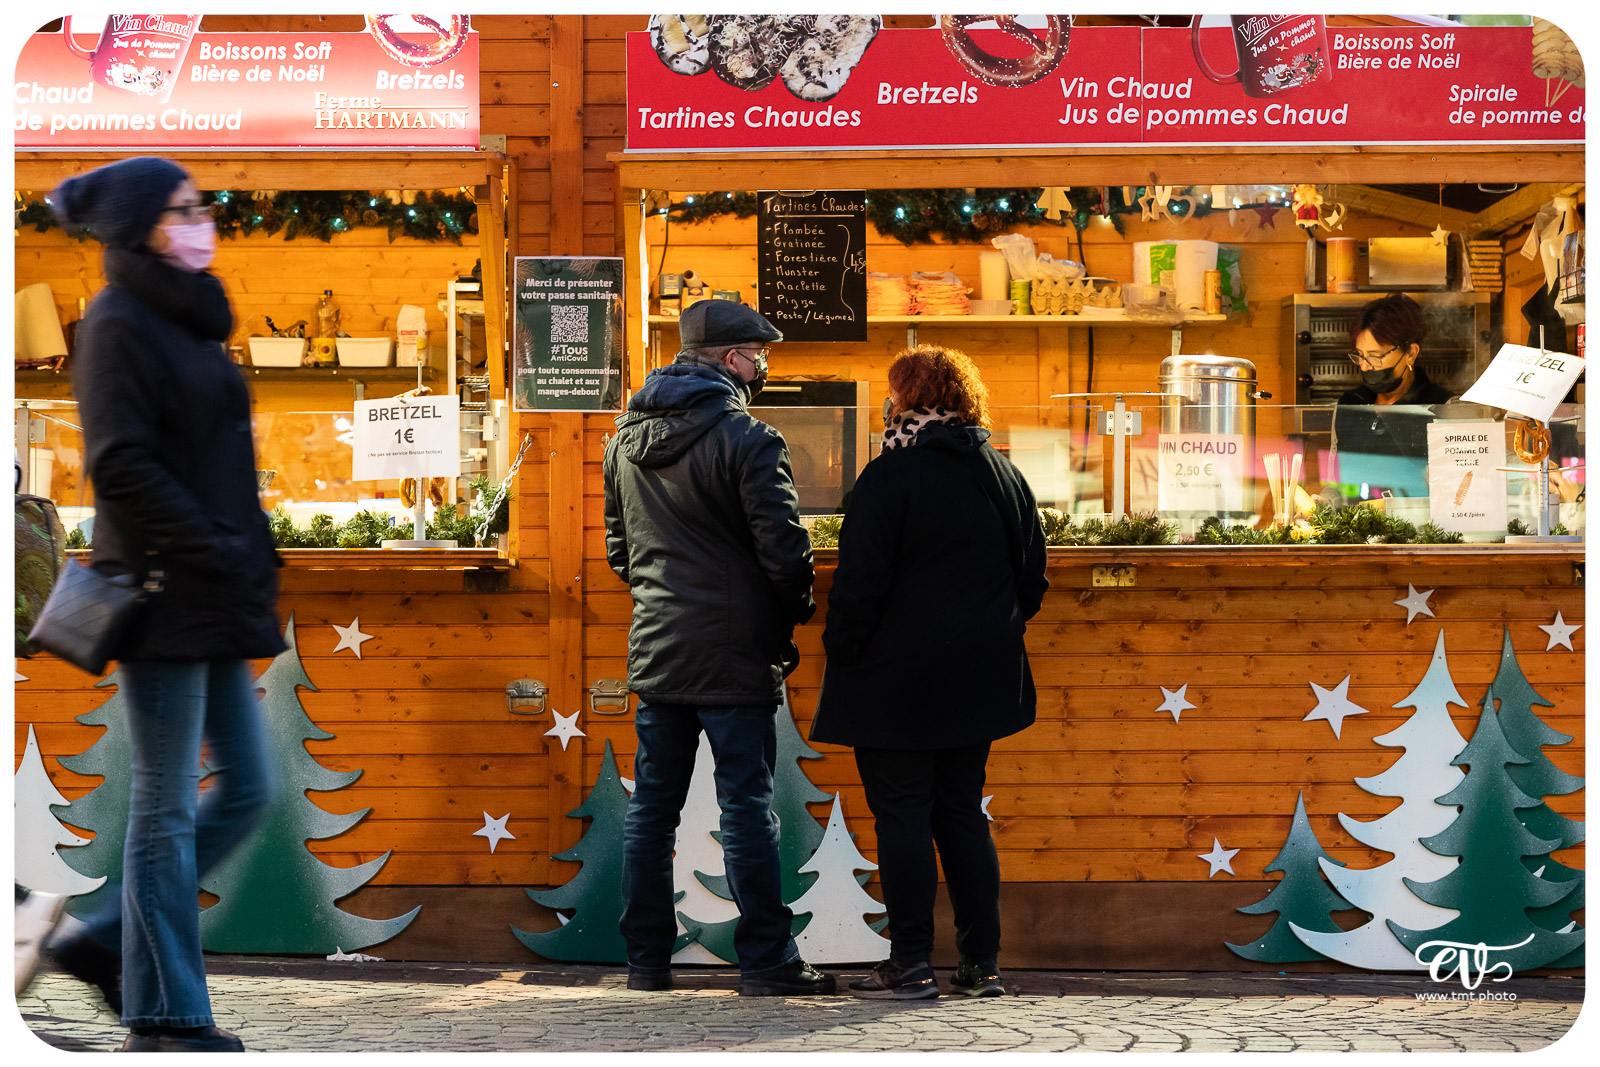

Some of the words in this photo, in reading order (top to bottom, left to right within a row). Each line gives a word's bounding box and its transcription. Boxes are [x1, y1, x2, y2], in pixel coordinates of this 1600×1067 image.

[112, 14, 142, 31] Vin
[144, 14, 192, 37] Chaud
[1238, 16, 1270, 41] Vin
[144, 39, 180, 50] Pommes
[1251, 43, 1268, 58] Jus
[1268, 36, 1279, 48] de
[1280, 17, 1316, 40] Pommes
[1290, 26, 1317, 47] chaud
[1333, 33, 1414, 50] Boissons
[1420, 33, 1455, 50] Soft
[199, 42, 287, 60] Boissons
[292, 41, 332, 60] Soft
[1337, 52, 1382, 69] Bière
[1387, 54, 1412, 69] de
[1418, 52, 1460, 69] Noël
[190, 65, 240, 83] Bière
[245, 65, 273, 83] de
[278, 64, 326, 83] Noël
[375, 69, 465, 91] Bretzels
[14, 82, 94, 104] Chaud
[877, 80, 979, 105] Bretzels
[1060, 77, 1098, 98] Vin
[1107, 77, 1192, 99] Chaud
[1448, 84, 1518, 106] Spirale
[313, 91, 383, 110] Ferme
[14, 109, 43, 131] de
[50, 114, 156, 135] pommes
[160, 109, 242, 131] Chaud
[313, 110, 468, 130] HARTMANN
[638, 106, 736, 129] Tartines
[743, 105, 861, 128] Chaudes
[1058, 103, 1098, 125] Jus
[1107, 103, 1139, 124] de
[1146, 107, 1258, 130] pommes
[1263, 103, 1349, 125] Chaud
[1448, 106, 1476, 125] de
[1481, 109, 1562, 128] pomme
[763, 194, 817, 213] Tartines
[821, 196, 865, 212] Chaudes
[774, 222, 825, 235] Flambée
[773, 237, 826, 248] Gratinée
[775, 250, 838, 262] Forestière
[776, 265, 820, 276] Munster
[525, 278, 552, 288] Merci
[554, 278, 566, 288] de
[567, 278, 614, 290] présenter
[776, 280, 827, 291] Raclette
[520, 291, 546, 300] votre
[548, 292, 576, 302] passe
[577, 291, 618, 300] sanitaire
[777, 294, 816, 310] Pizza
[551, 344, 588, 355] #Tous
[517, 368, 536, 376] pour
[538, 367, 560, 375] toute
[561, 367, 620, 375] consommation
[1507, 353, 1565, 373] RETZEL
[548, 377, 573, 385] chalet
[1516, 371, 1535, 384] 1€
[537, 387, 600, 398] manges-debout
[368, 405, 442, 422] BRETZEL
[394, 428, 415, 444] 1€
[1478, 434, 1489, 442] DE
[1160, 441, 1177, 454] VIN
[1181, 441, 1237, 454] CHAUD
[1479, 446, 1489, 454] DE
[1175, 463, 1200, 477] 2,50
[1204, 463, 1213, 476] €
